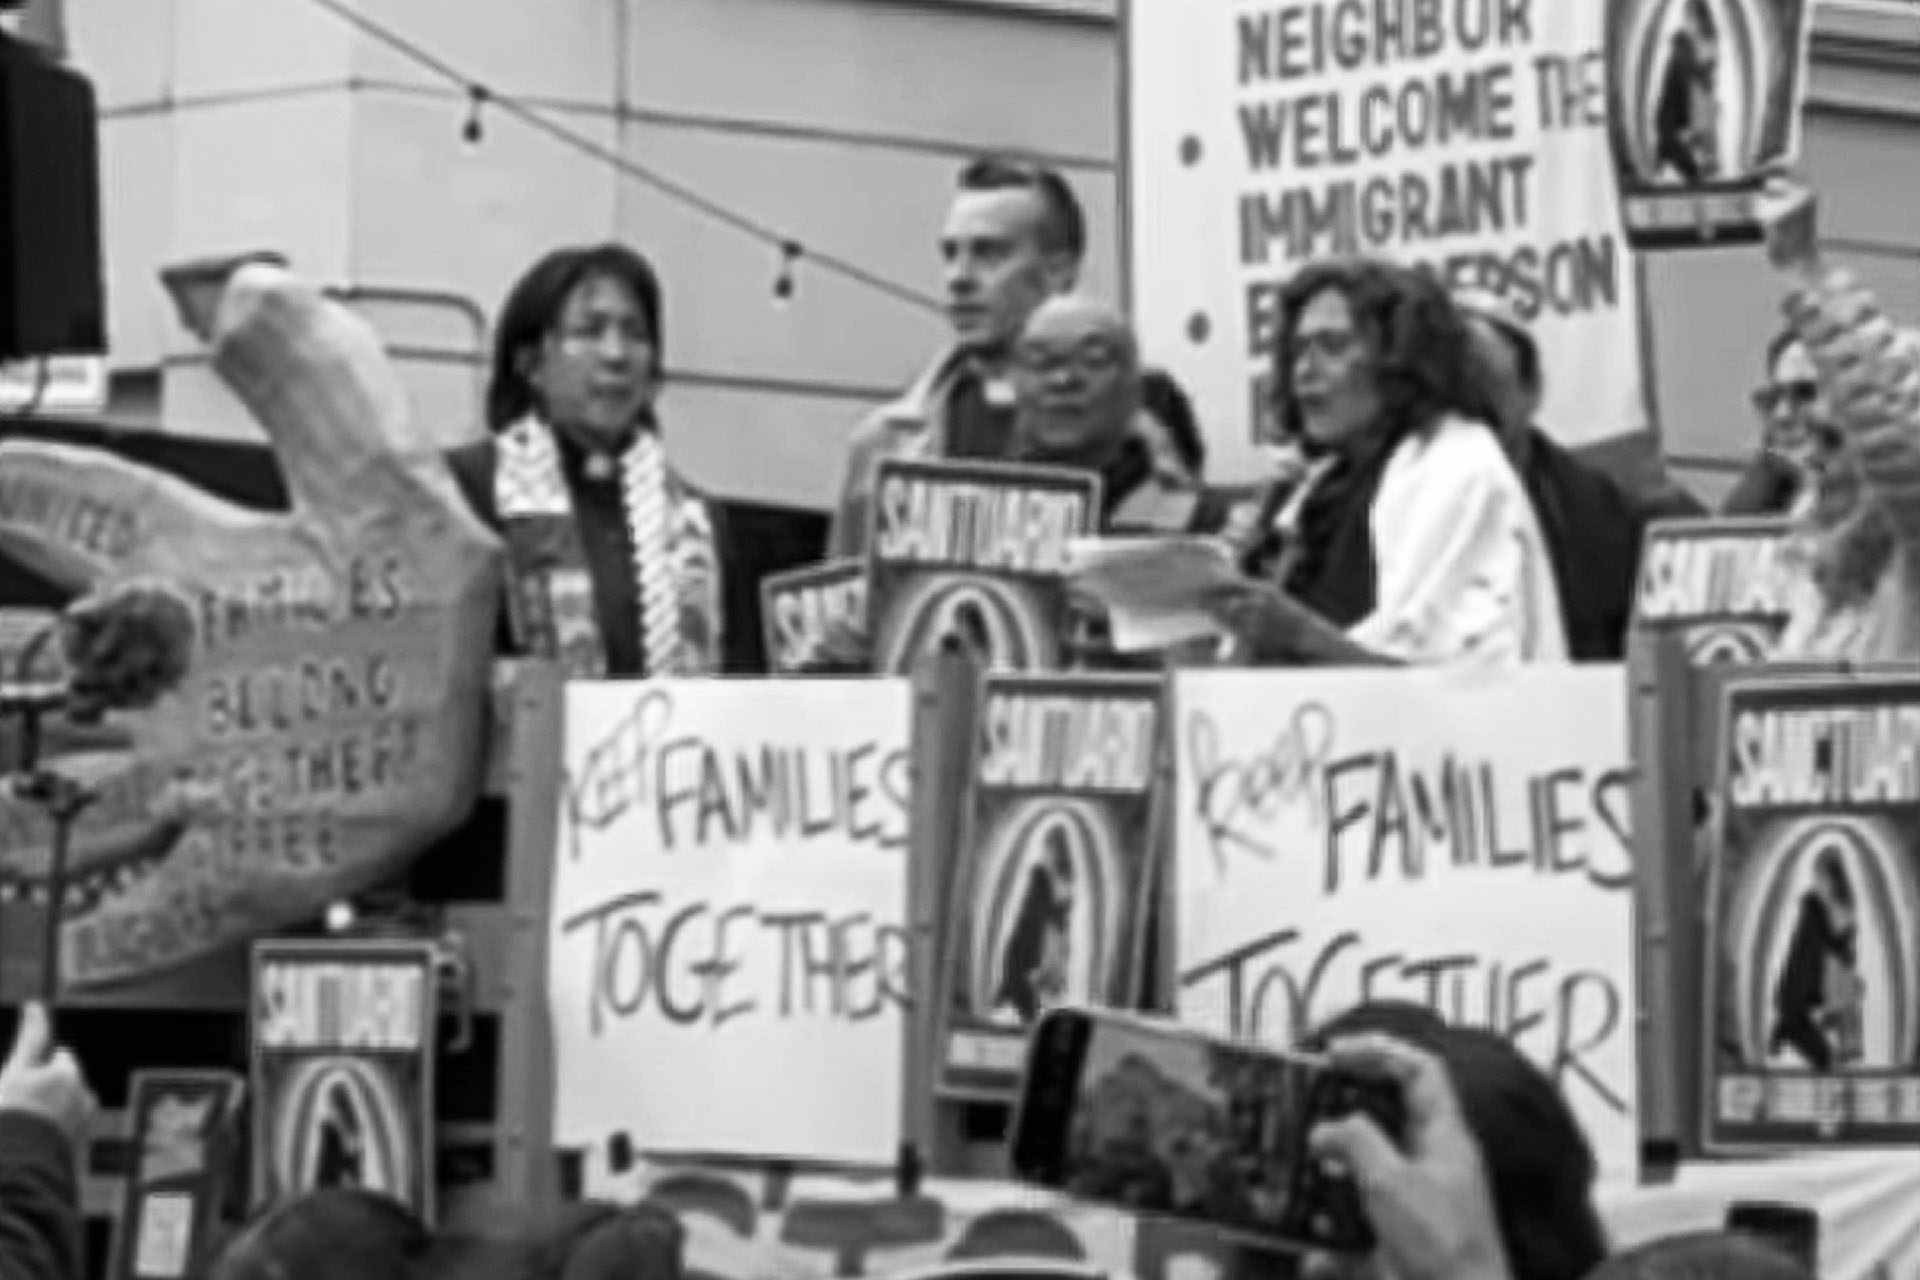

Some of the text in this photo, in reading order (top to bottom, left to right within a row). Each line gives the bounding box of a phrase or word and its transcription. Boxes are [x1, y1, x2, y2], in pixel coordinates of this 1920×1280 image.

[1237, 0, 1532, 86] NEIGHBOR
[1237, 62, 1513, 171] WELCOME
[1239, 154, 1533, 264] IMMIGRANT
[655, 736, 915, 851] FAMILIES
[1323, 747, 1642, 895] FAMILIES
[562, 889, 915, 1038] TOGETHER
